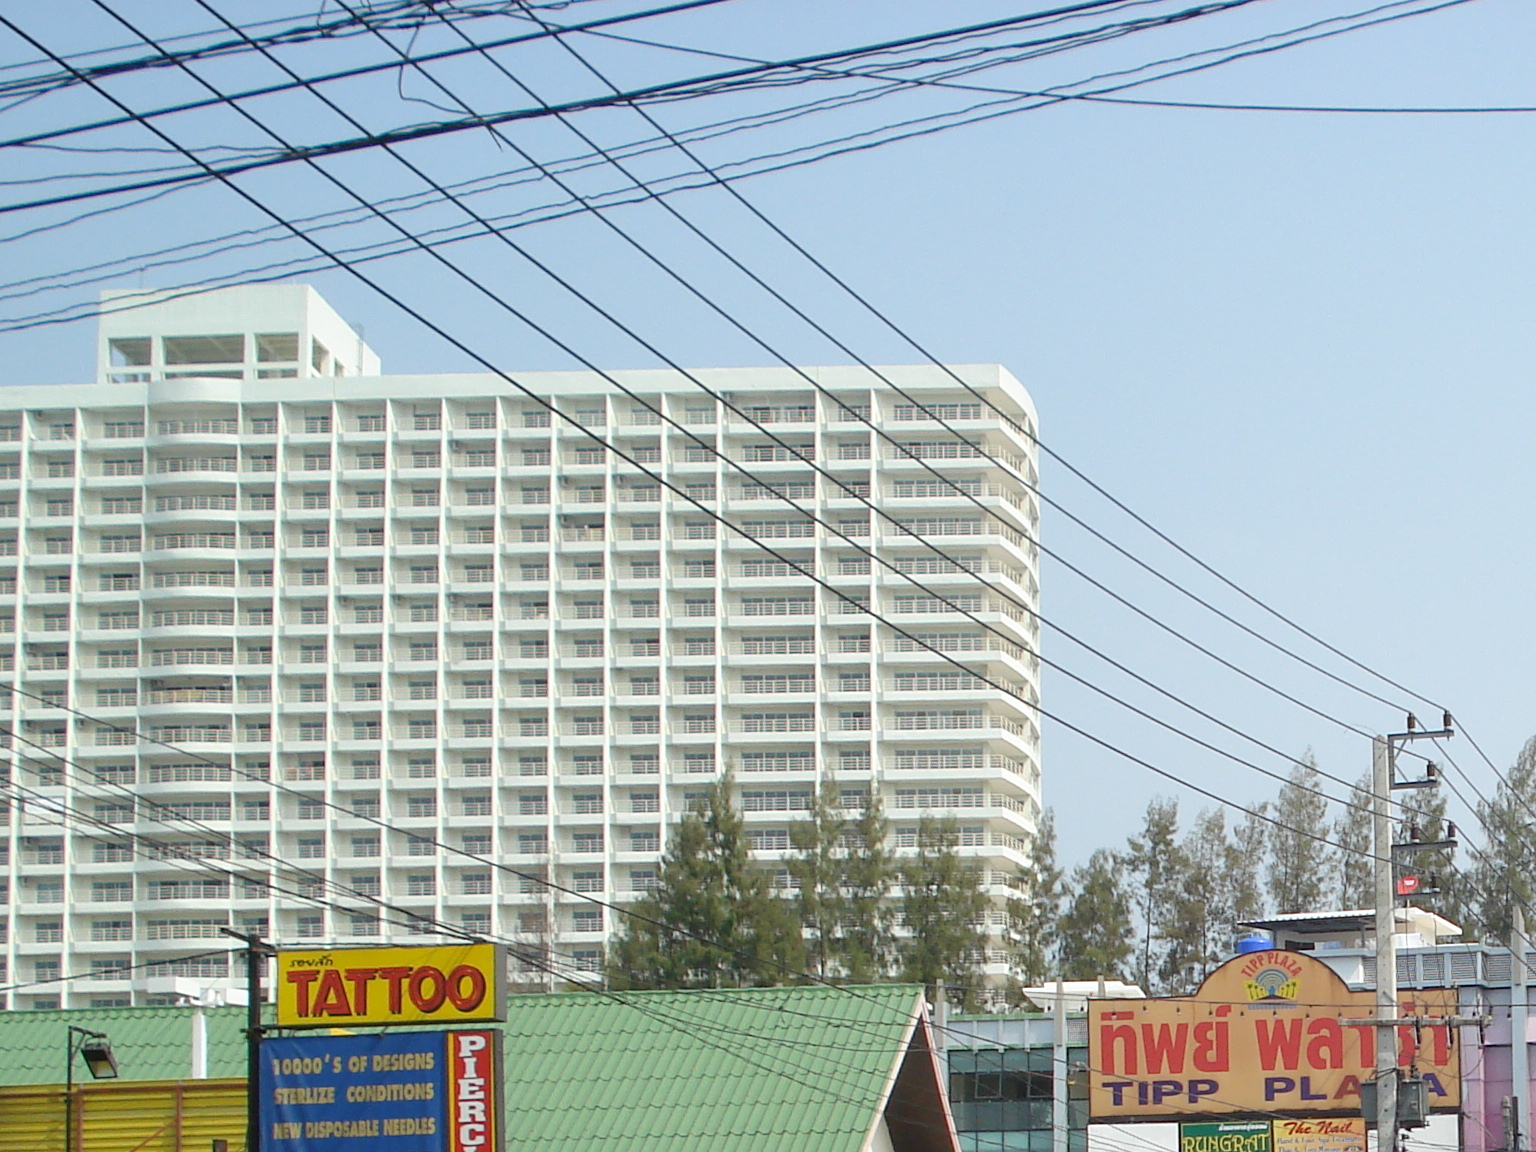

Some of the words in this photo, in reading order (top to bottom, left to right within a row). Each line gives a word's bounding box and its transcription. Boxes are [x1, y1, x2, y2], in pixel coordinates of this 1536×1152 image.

[1240, 955, 1265, 977] TIPP
[1267, 952, 1303, 977] PLAZA
[287, 964, 487, 1017] TATTOO
[1100, 1004, 1232, 1076] ทิพย์
[273, 1054, 342, 1076] 10000'S
[348, 1057, 368, 1073] OF
[373, 1053, 434, 1071] DESIGNS
[274, 1087, 335, 1104] STERLIZE
[347, 1082, 434, 1103] CONDITIONS
[1102, 1078, 1219, 1106] TIPP
[1265, 1072, 1448, 1101] PLAA
[273, 1122, 302, 1139] NEW
[306, 1119, 379, 1138] DISPOSABLE
[384, 1117, 435, 1136] NEEDLES
[1284, 1121, 1311, 1135] The
[1316, 1121, 1352, 1135] Nail
